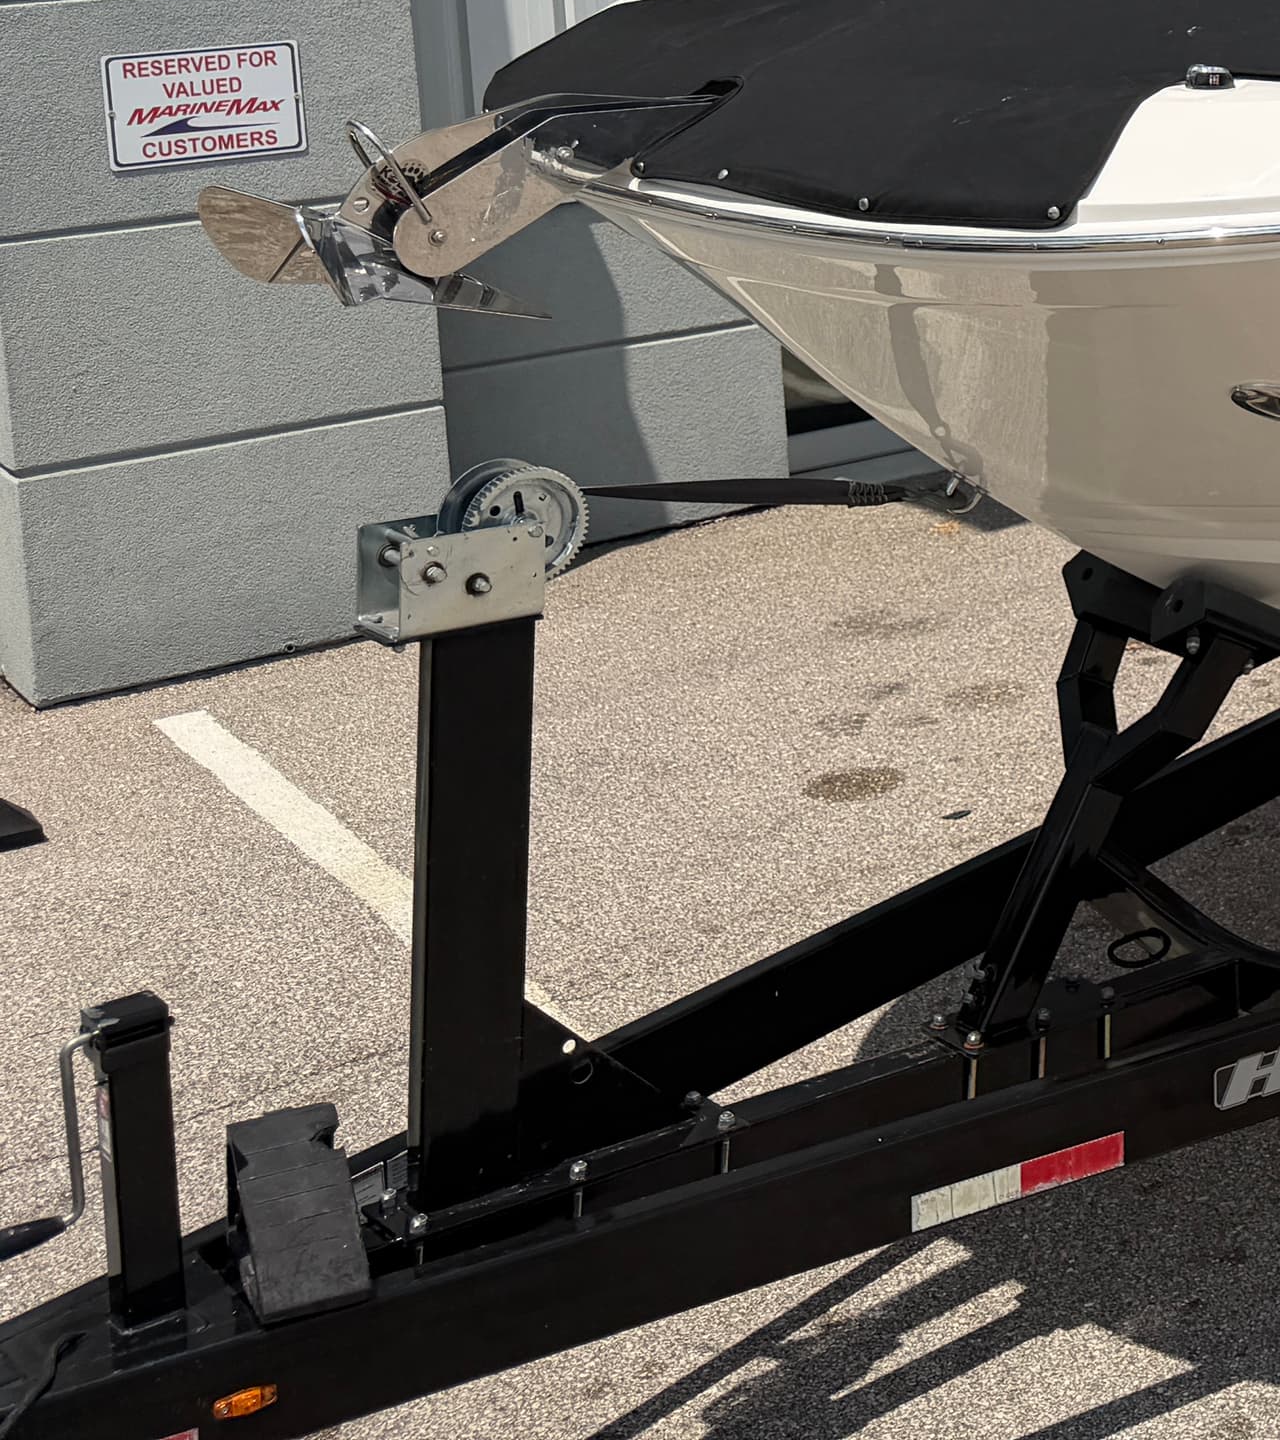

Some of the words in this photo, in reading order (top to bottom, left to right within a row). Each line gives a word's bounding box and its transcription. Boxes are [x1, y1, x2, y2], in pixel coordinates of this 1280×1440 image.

[122, 54, 231, 79] RESERVED
[237, 50, 278, 69] FOR
[162, 77, 242, 99] VALUED
[142, 129, 278, 159] CUSTOMERS
